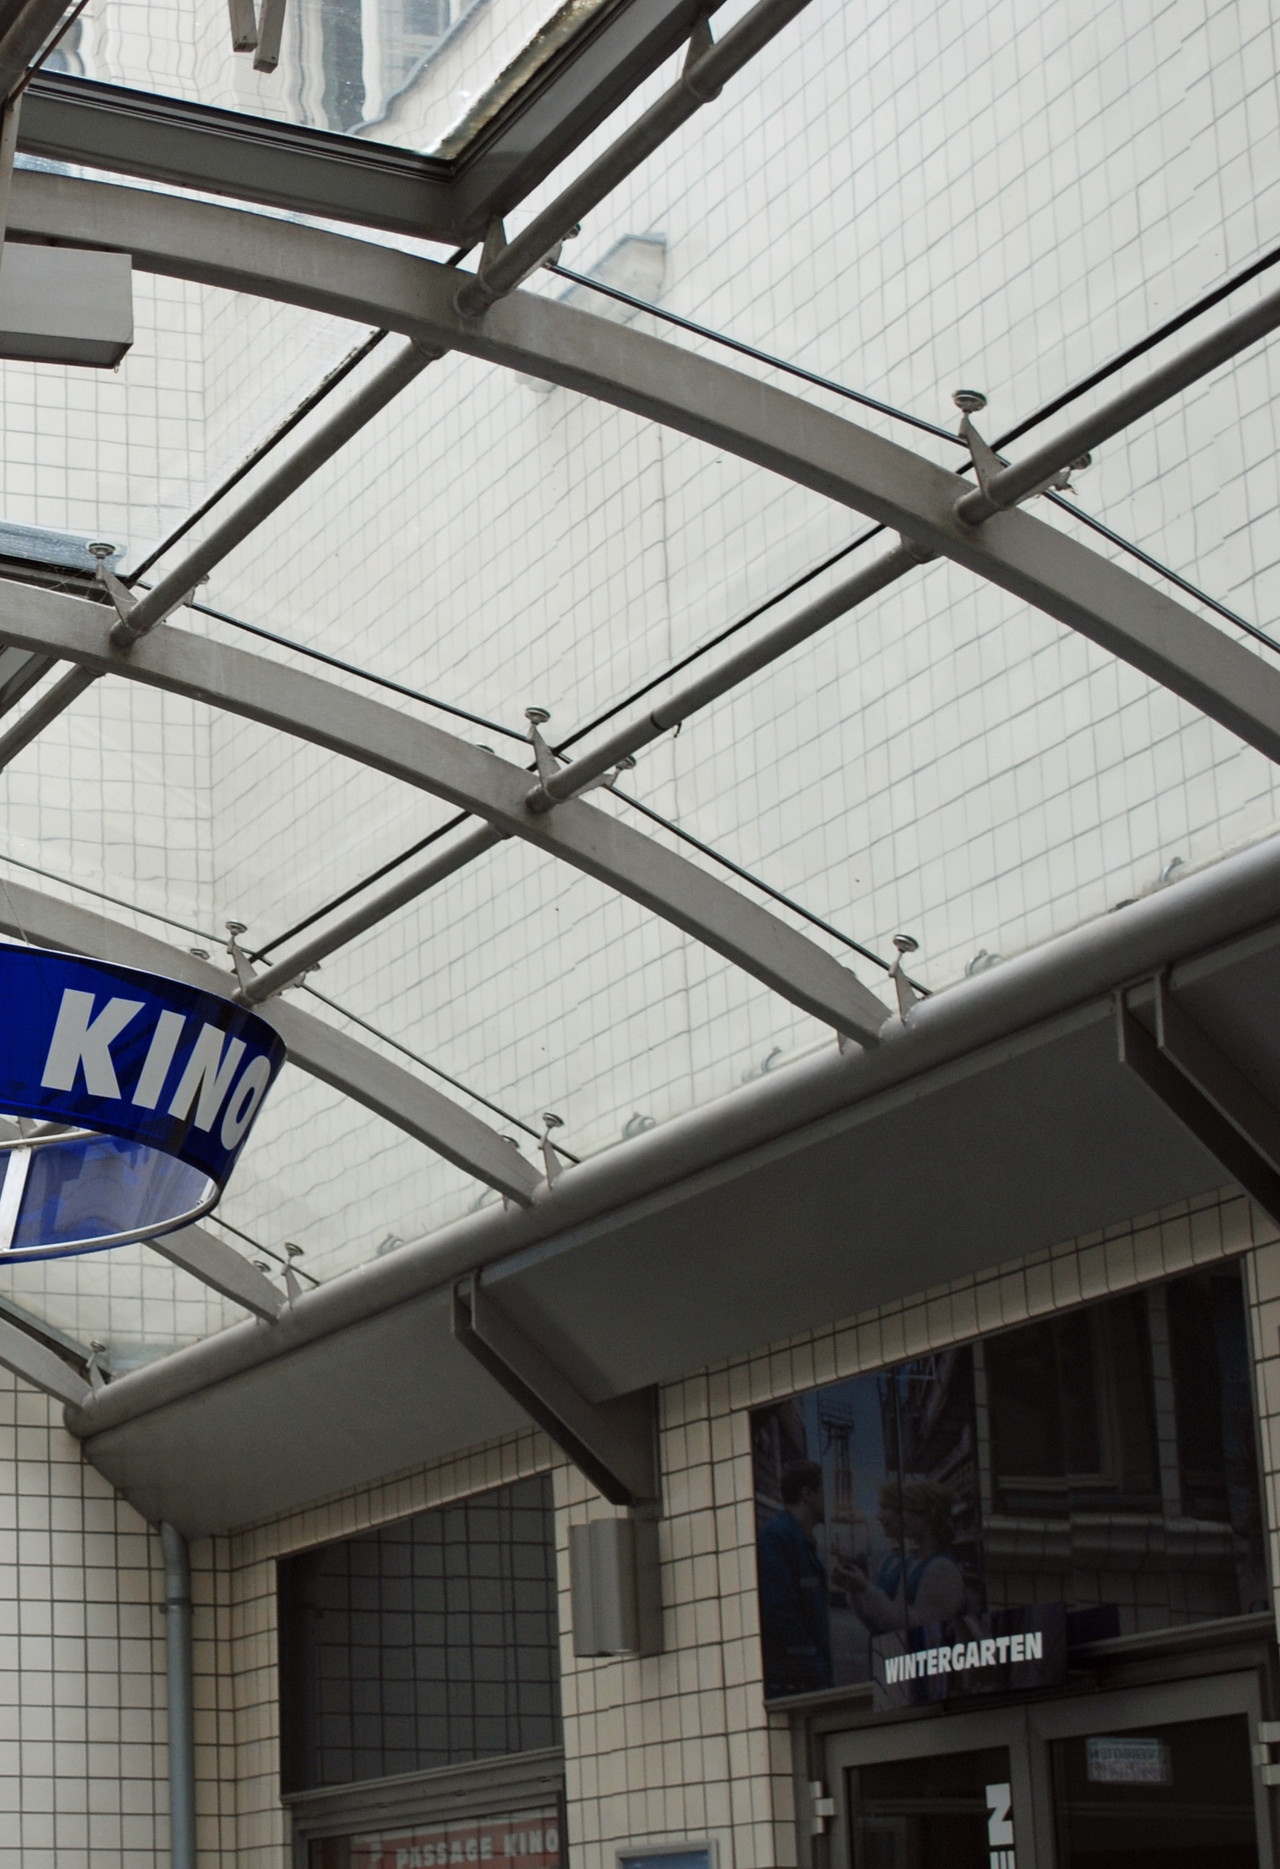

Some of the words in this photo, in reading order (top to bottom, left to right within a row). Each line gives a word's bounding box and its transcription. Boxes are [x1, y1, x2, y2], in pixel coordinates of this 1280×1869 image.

[38, 987, 272, 1151] KINO
[884, 1631, 1043, 1685] WINTERGARTEN
[395, 1836, 494, 1869] PASSAGE
[504, 1828, 559, 1859] KINO
